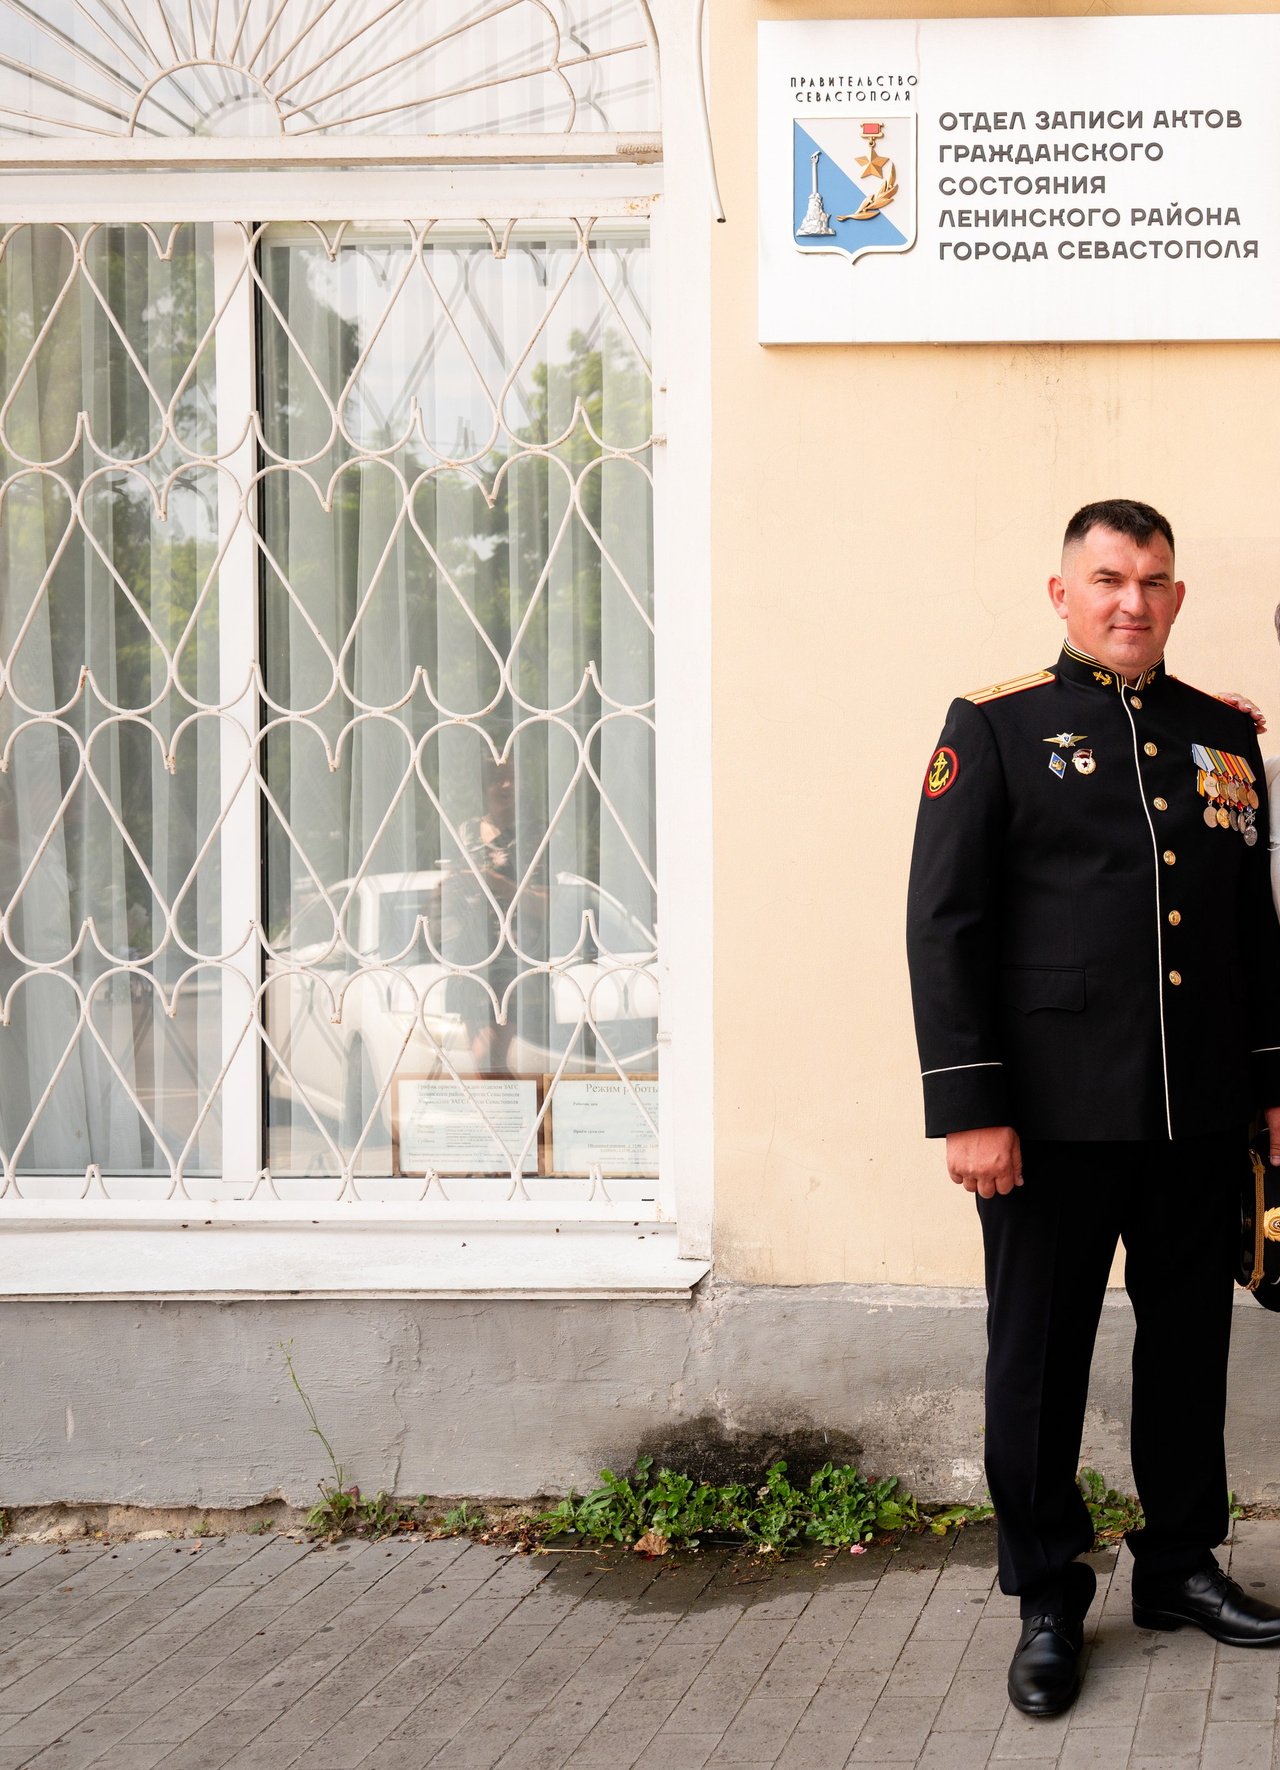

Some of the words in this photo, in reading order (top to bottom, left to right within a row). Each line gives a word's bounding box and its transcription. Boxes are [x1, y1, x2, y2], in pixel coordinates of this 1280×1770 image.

[790, 75, 918, 88] ПРАВИТЕЛЬСТВО
[795, 90, 911, 103] СЕВАСТОПОЛЯ
[938, 111, 1027, 133] ОТДЕЛ
[1035, 110, 1144, 131] ЗАПИСИ
[1152, 109, 1243, 129] АКТОВ
[938, 142, 1164, 165] ГРАЖДАНСКОГО
[938, 175, 1106, 196] СОСТОЯНИЯ
[938, 207, 1121, 229] ЛЕНИНСКОГО
[1130, 201, 1242, 227] РАЙОНА
[938, 241, 1049, 263] ГОРОДА
[1057, 239, 1260, 260] СЕВАСТОПОЛЯ
[585, 1083, 621, 1093] Режим
